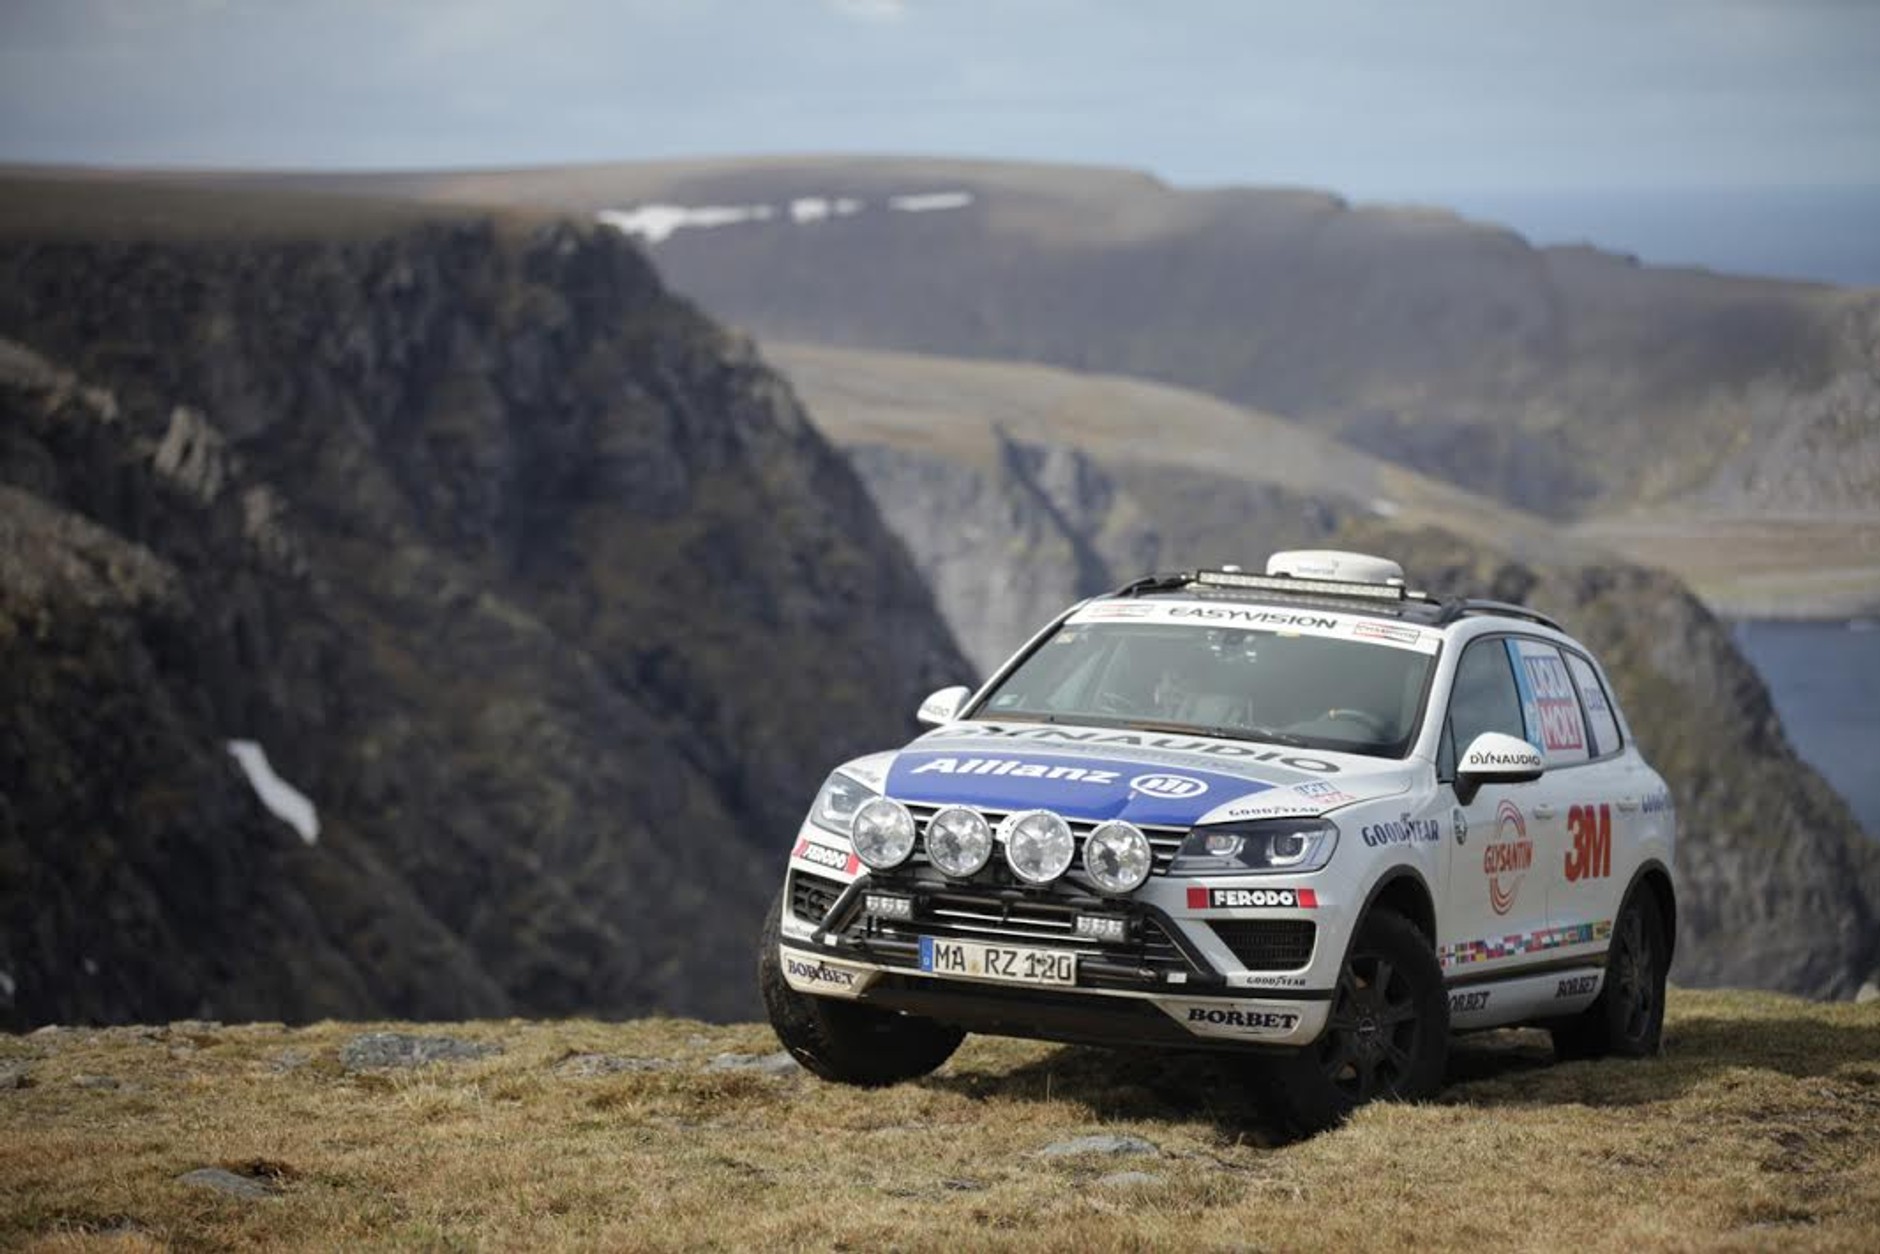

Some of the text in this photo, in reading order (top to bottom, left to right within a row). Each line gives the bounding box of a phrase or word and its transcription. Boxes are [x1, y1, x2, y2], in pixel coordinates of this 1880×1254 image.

[1167, 606, 1338, 630] EASYVISION
[928, 725, 1341, 773] DYNAUDIO
[1470, 751, 1541, 766] DYNAUDIO
[909, 758, 1122, 786] Allianz
[1361, 812, 1439, 848] GOODYEAR
[1564, 804, 1612, 882] 3M
[1213, 889, 1295, 907] FERODO
[787, 959, 854, 985] BORBET
[935, 943, 1071, 981] MA RZ 120
[1246, 975, 1306, 987] GOODYEAR
[1448, 991, 1491, 1013] ORBET
[1188, 1007, 1299, 1030] BORBET
